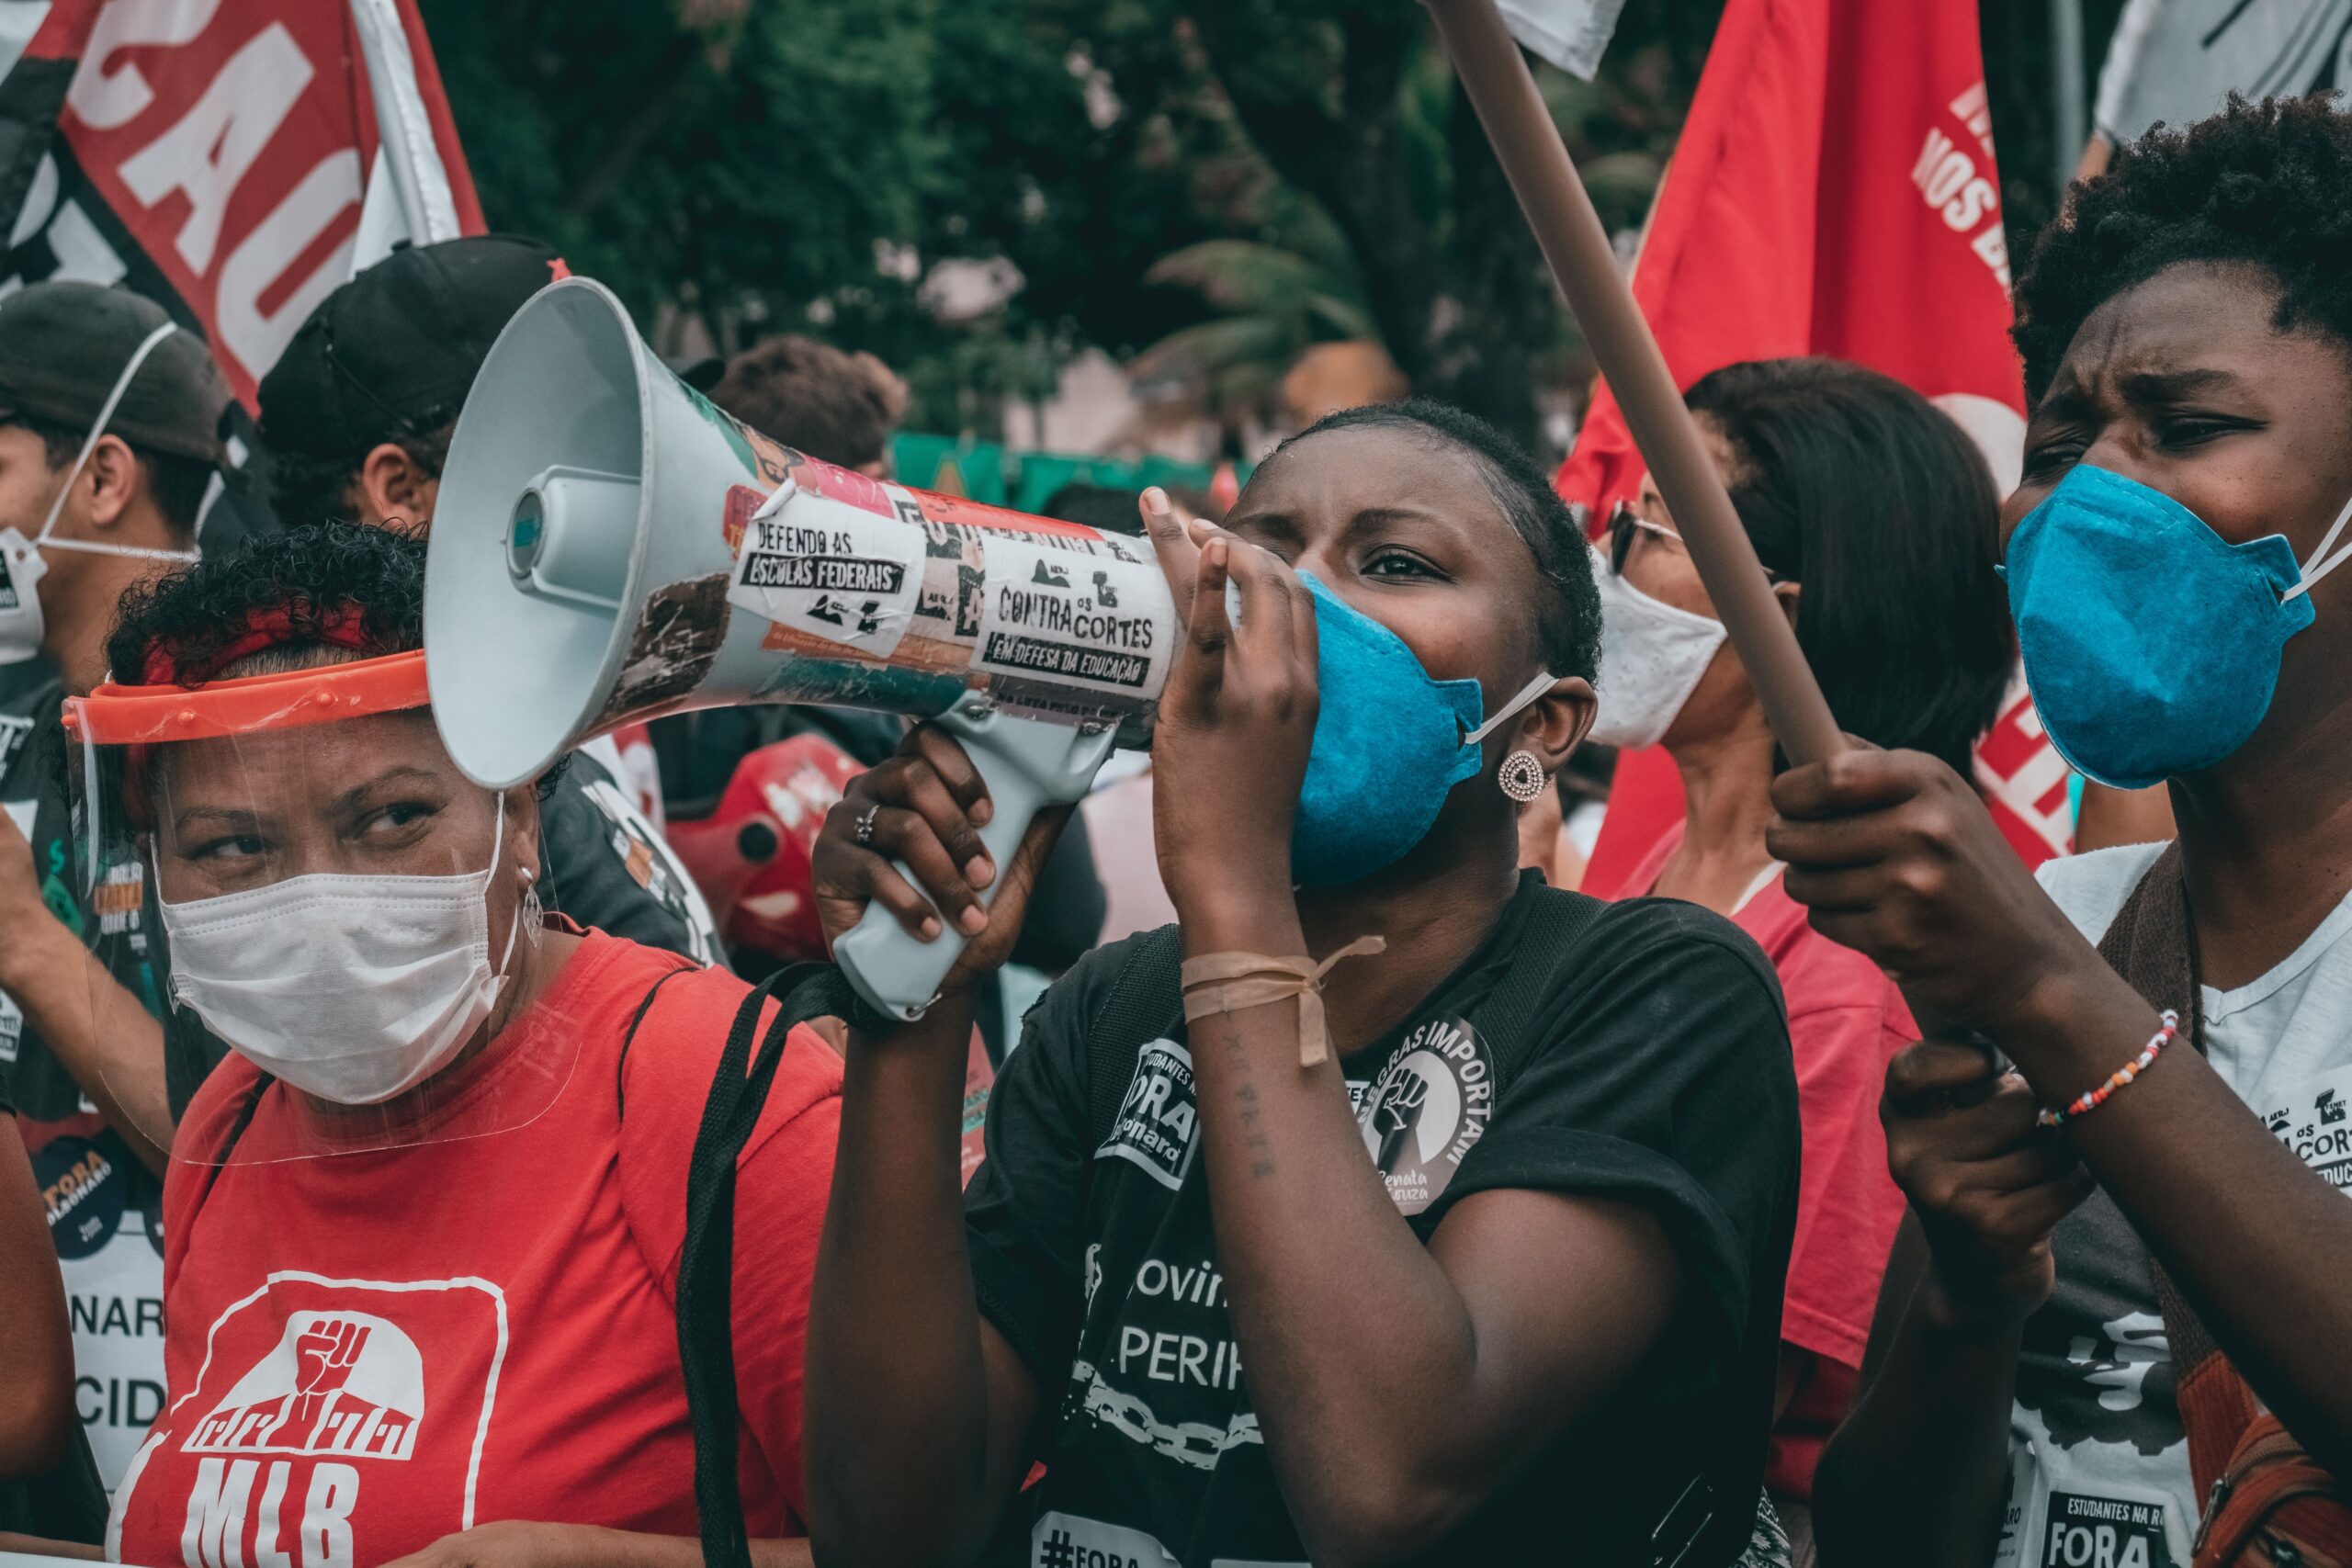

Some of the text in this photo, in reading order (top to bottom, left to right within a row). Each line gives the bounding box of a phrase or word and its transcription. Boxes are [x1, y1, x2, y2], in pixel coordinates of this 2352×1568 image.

[758, 522, 826, 554] DEFENDO
[831, 532, 853, 554] AS
[749, 557, 894, 591] ESCOLAS FEDERAIS
[998, 584, 1072, 633] CONTRA
[1073, 614, 1154, 650] CORTES
[992, 638, 1143, 684] EM DEFESA DA EDUCAÇÃO
[2268, 1107, 2290, 1122] AERJ
[1110, 1118, 1182, 1162] onaro
[2296, 1128, 2352, 1162] COR
[1386, 1187, 1429, 1201] ouza
[181, 1457, 360, 1568] MLB
[2067, 1496, 2131, 1522] ESTUDANTES
[2132, 1505, 2149, 1525] NA
[2048, 1521, 2151, 1568] FORA
